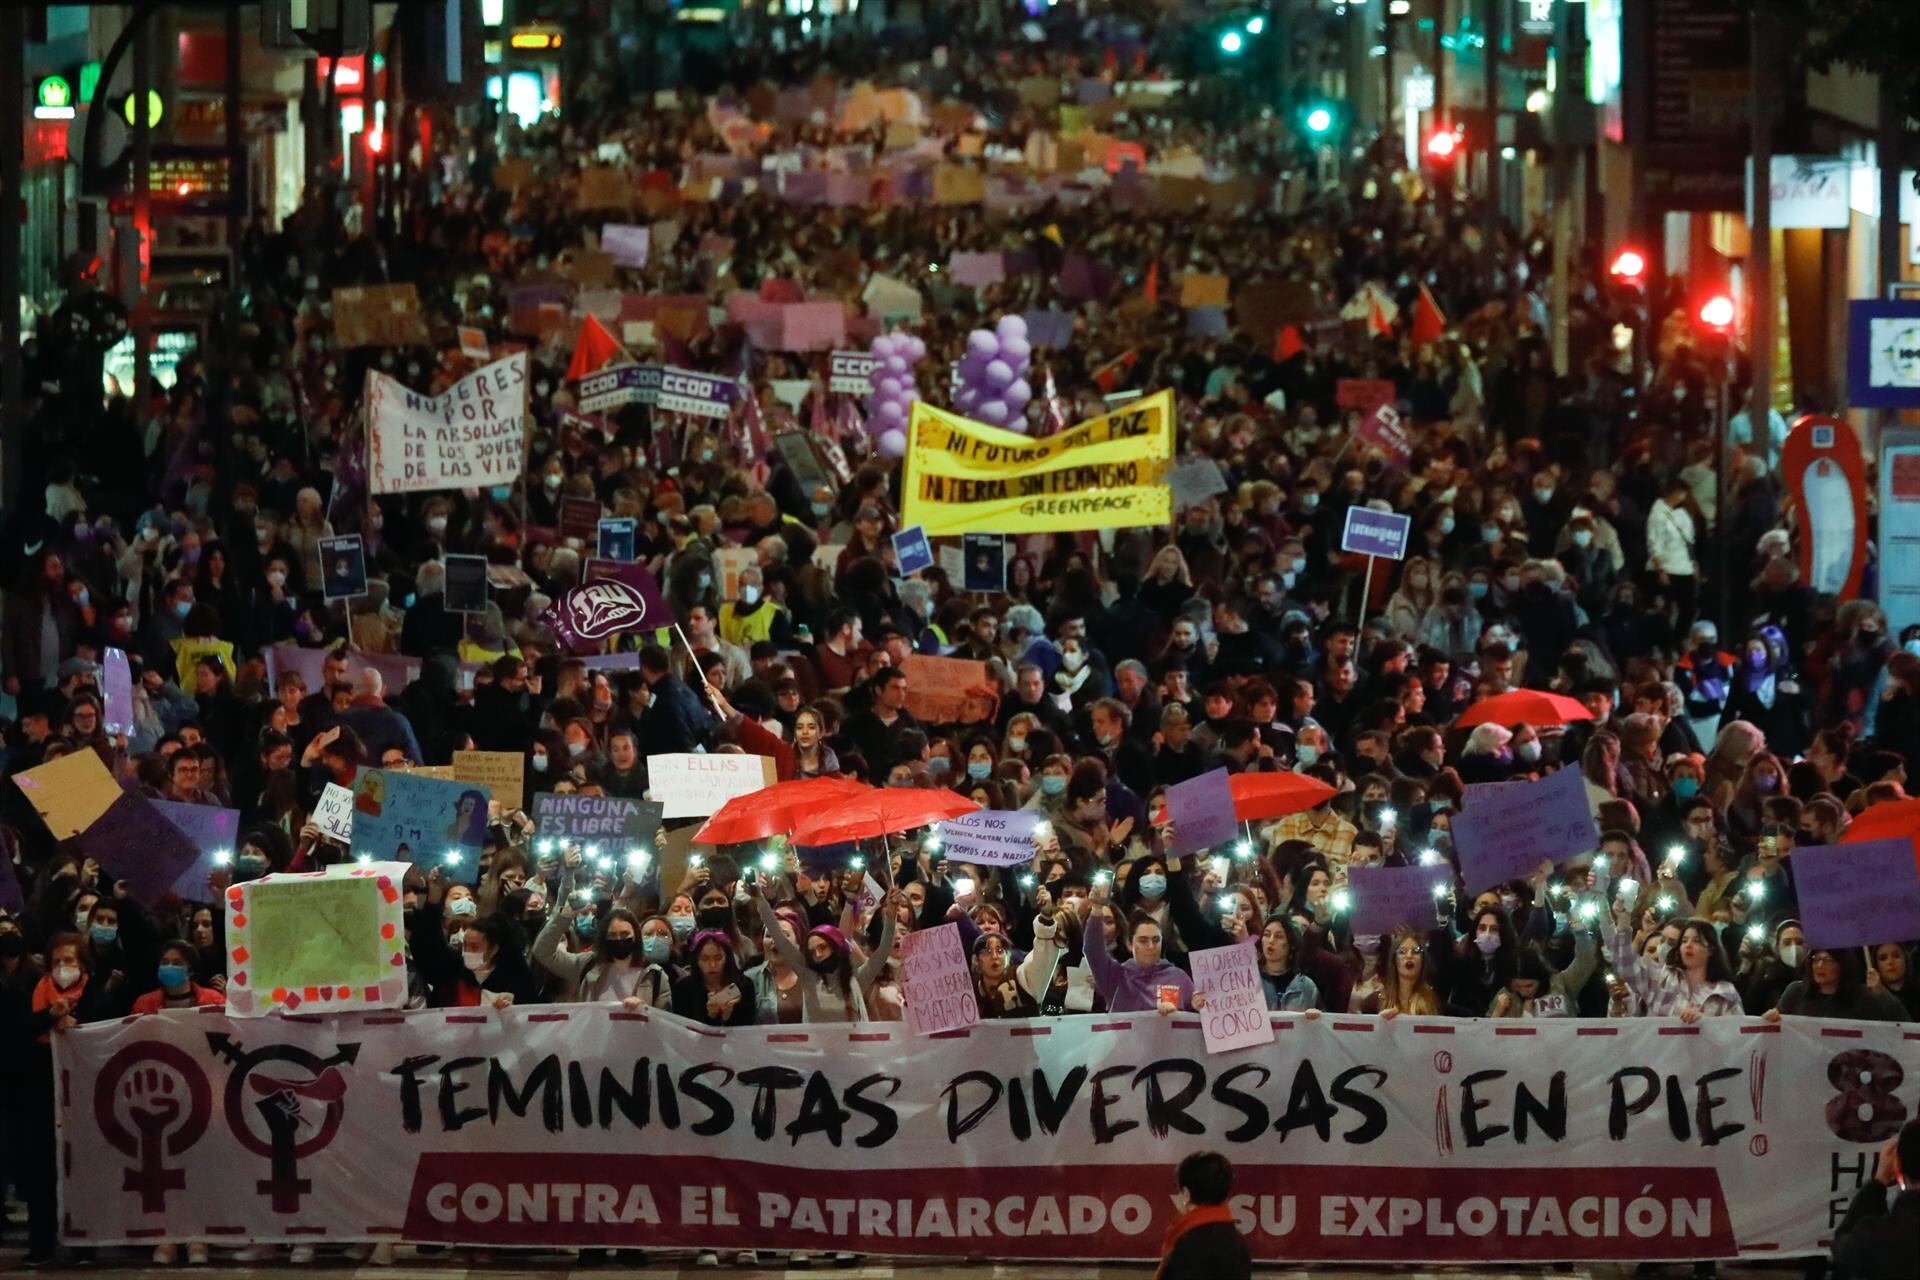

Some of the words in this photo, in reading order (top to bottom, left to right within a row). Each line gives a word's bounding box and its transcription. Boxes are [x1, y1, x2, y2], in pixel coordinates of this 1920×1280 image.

[661, 373, 713, 399] CCOO
[445, 399, 497, 425] POR
[404, 423, 427, 441] LA
[947, 432, 968, 455] NI
[973, 440, 1051, 463] FUTURO
[1108, 411, 1150, 440] PAZ
[405, 442, 425, 458] DE
[438, 445, 465, 460] LOS
[405, 462, 426, 479] DE
[441, 462, 472, 476] LAS
[926, 474, 944, 501] NI
[948, 479, 1008, 503] TIERRA
[1019, 475, 1044, 496] SIN
[1052, 462, 1138, 492] FEMINISMO
[1019, 494, 1138, 517] GREENPEACE
[687, 757, 739, 772] ELLAS
[321, 799, 341, 815] NO
[539, 797, 640, 817] NINGUNA
[540, 815, 567, 835] ES
[571, 817, 626, 836] LIBRE
[984, 819, 1007, 830] NOS
[953, 844, 979, 856] SOMOS
[981, 848, 999, 860] LAS
[1196, 956, 1209, 975] SI
[1219, 968, 1255, 993] CENA
[914, 992, 976, 1032] MATADO
[391, 1054, 901, 1147] FEMINISTAS
[940, 1058, 1388, 1145] DIVERSAS
[1607, 1050, 1768, 1156] PIE!
[426, 1183, 662, 1225] CONTRA
[681, 1186, 740, 1225] EL
[758, 1193, 1153, 1238] PATRIARCADO
[1228, 1194, 1297, 1237] SU
[1319, 1184, 1712, 1239] EXPLOTACIÓN
